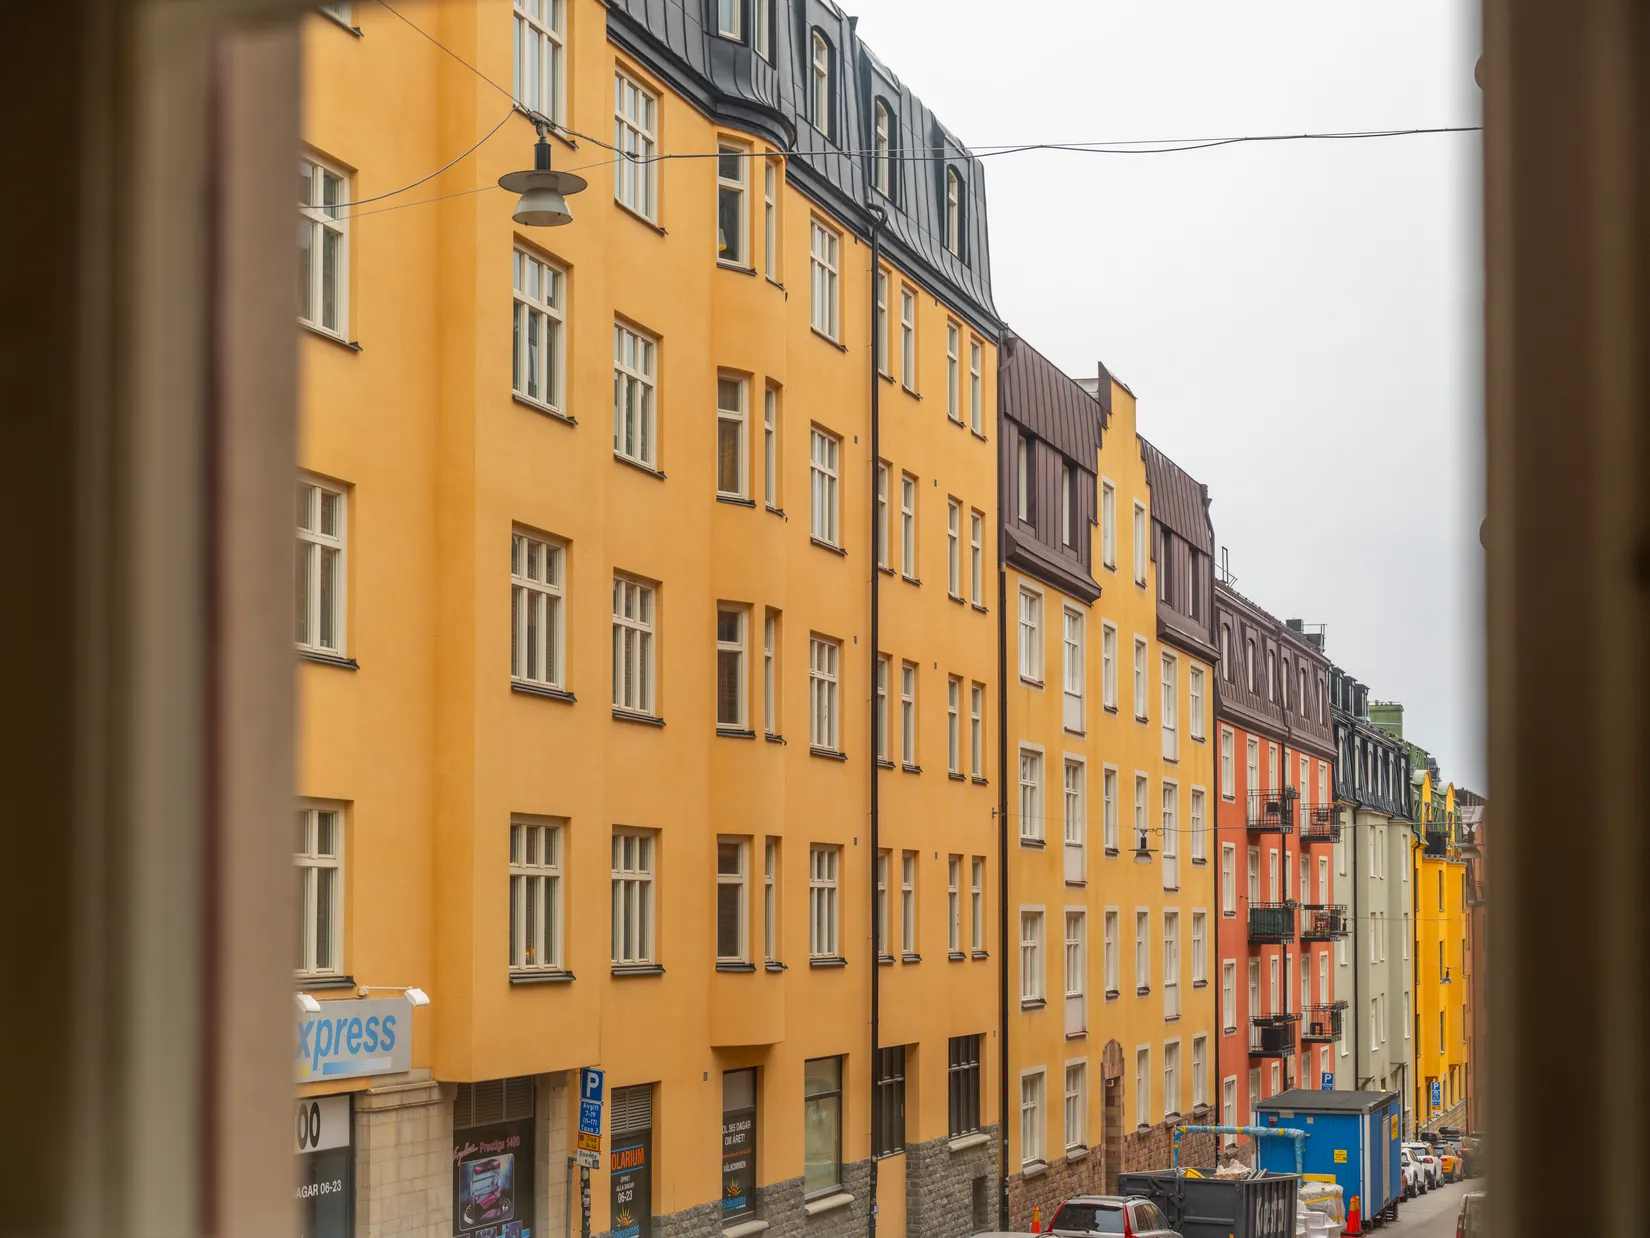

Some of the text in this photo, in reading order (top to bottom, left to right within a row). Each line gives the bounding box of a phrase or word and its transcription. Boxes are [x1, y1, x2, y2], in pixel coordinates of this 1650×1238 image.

[586, 1071, 600, 1098] P
[1324, 1073, 1332, 1084] P
[1433, 1082, 1440, 1090] P
[583, 1102, 600, 1111] Avgift
[581, 1124, 594, 1132] Taxa
[736, 1120, 751, 1132] DAGAR
[611, 1147, 645, 1171] OLARIUM
[294, 1180, 342, 1199] AGAR 06-23
[617, 1190, 633, 1204] 06-23
